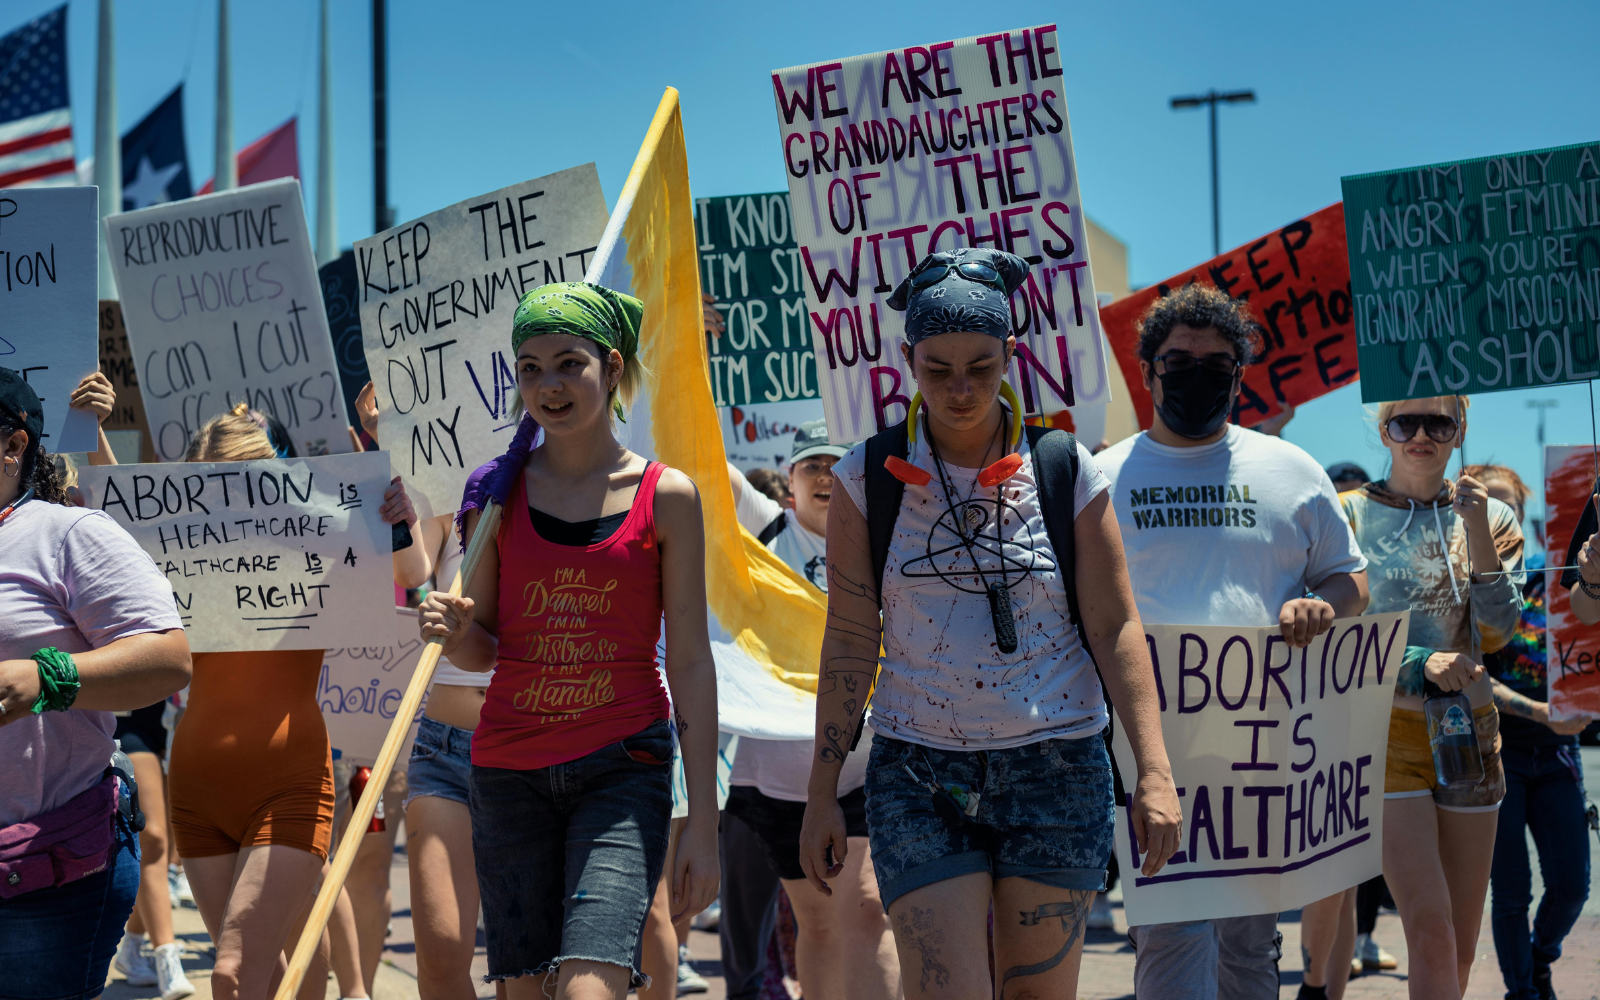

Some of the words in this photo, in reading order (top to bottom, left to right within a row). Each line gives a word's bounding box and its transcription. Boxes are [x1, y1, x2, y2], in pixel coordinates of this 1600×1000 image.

[771, 62, 849, 125] WE
[881, 41, 962, 108] ARE
[976, 24, 1064, 88] THE
[784, 89, 1064, 178] GRANDDAUGHTERS
[828, 172, 881, 235] OF
[934, 144, 1041, 214] THE
[1417, 163, 1464, 200] I'M
[1485, 151, 1555, 191] ONLY
[1576, 144, 1600, 178] A
[119, 204, 289, 268] REPRODUCTIVE
[359, 221, 431, 303] KEEP
[468, 190, 545, 262] THE
[696, 197, 716, 251] I
[725, 194, 799, 249] KNO
[1360, 197, 1466, 254] ANGRY
[0, 243, 57, 292] ION
[703, 251, 749, 300] I'M
[800, 201, 1075, 304] WITCHES
[1366, 249, 1460, 290] WHEN
[1481, 234, 1579, 275] YOU'RE
[150, 260, 284, 322] CHOICES
[1354, 284, 1467, 347] IGNORANT
[144, 340, 211, 399] can
[231, 320, 247, 380] I
[809, 302, 882, 370] YOU
[1407, 322, 1600, 396] ASSHOL
[387, 338, 457, 415] OUT
[710, 354, 751, 407] I'M
[763, 351, 823, 402] SUC
[868, 335, 1076, 433] BN
[1231, 333, 1359, 426] AFE
[411, 405, 465, 477] MY
[101, 471, 314, 523] ABORTION
[339, 482, 359, 506] is
[1130, 484, 1258, 507] MEMORIAL
[1132, 507, 1257, 530] WARRIORS
[158, 514, 334, 555] HEALTHCARE
[1363, 530, 1410, 567] KEY
[155, 554, 281, 580] ALTHCARE
[343, 547, 358, 568] A
[554, 568, 575, 584] I'M
[575, 568, 587, 584] A
[235, 582, 331, 611] RIGHT
[522, 577, 618, 618] Damsel
[546, 615, 569, 629] I'M
[569, 615, 587, 629] IN
[522, 628, 618, 666] Distress
[513, 668, 616, 713] Handle
[1231, 712, 1318, 774] IS
[1125, 754, 1373, 870] ALTHCARE
